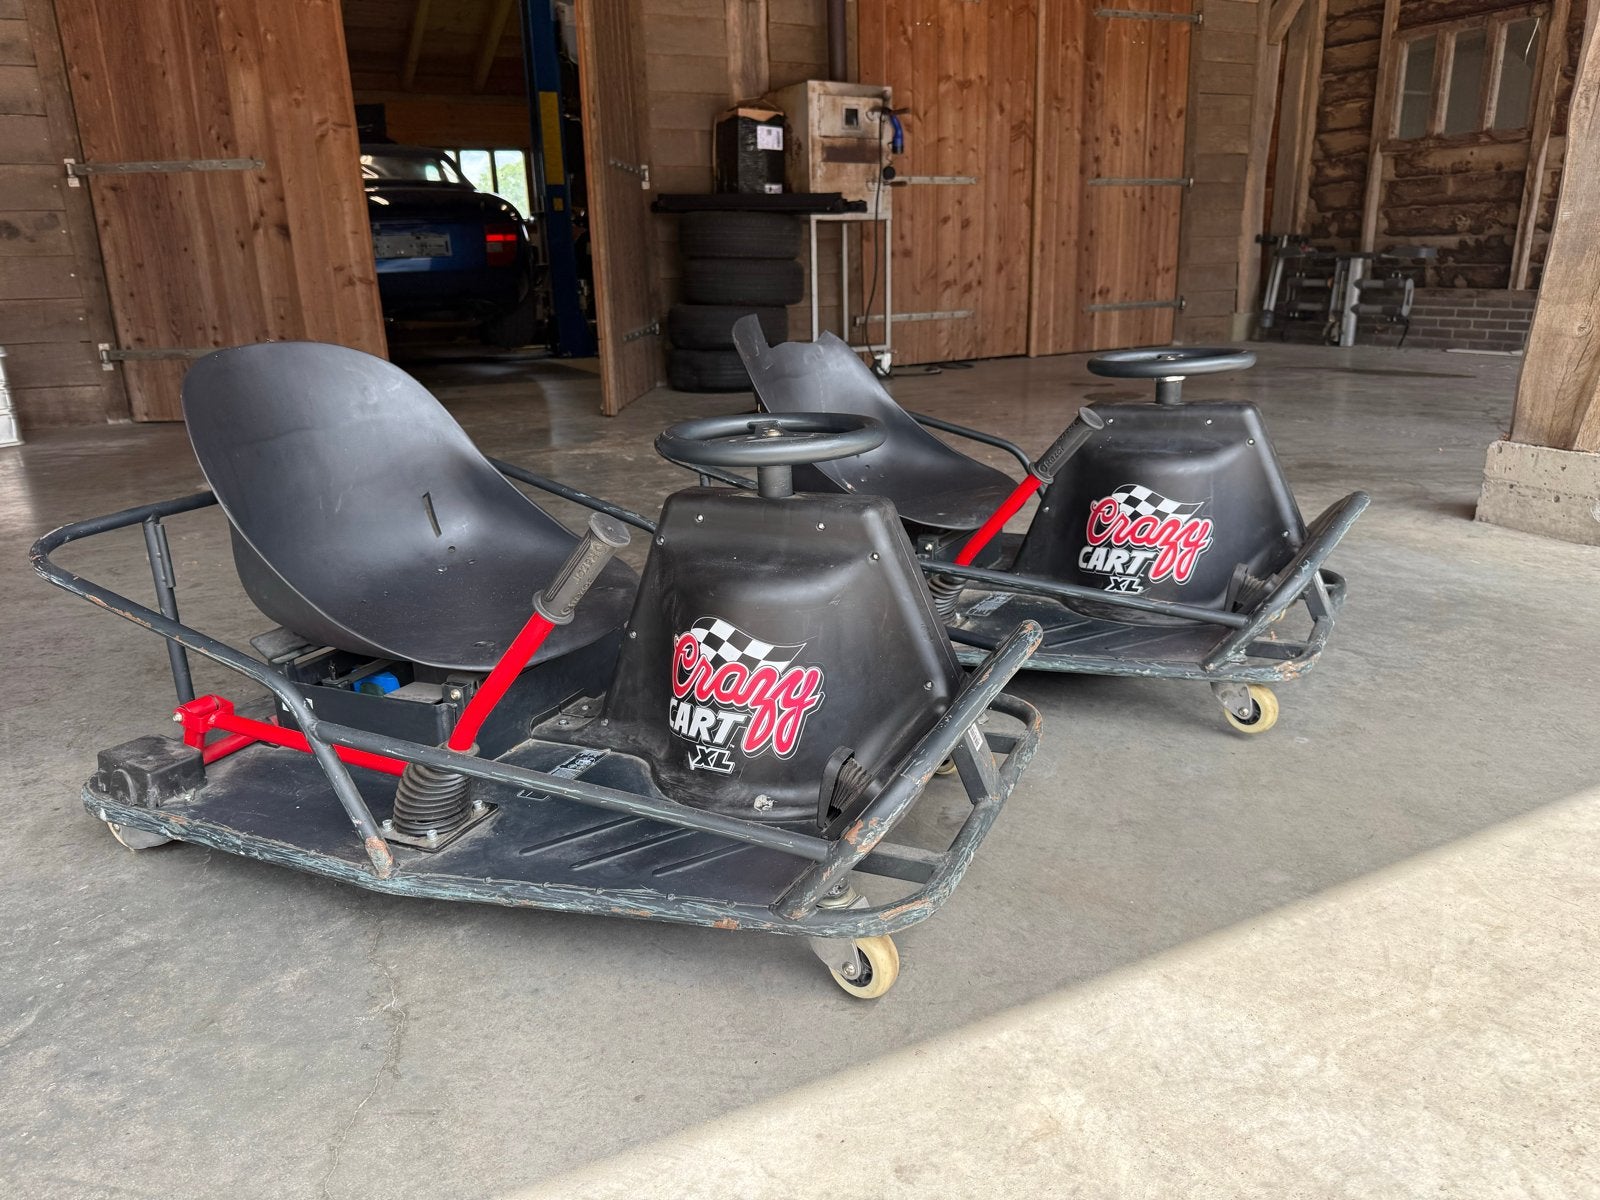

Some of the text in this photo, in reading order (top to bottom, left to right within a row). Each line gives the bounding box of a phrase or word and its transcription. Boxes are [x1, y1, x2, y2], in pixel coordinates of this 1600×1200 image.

[1086, 497, 1214, 584] Crazy
[1078, 546, 1157, 576] CART
[1104, 576, 1143, 594] XL
[672, 632, 826, 756] Crazy
[669, 698, 747, 744] CART
[692, 746, 735, 774] XL
